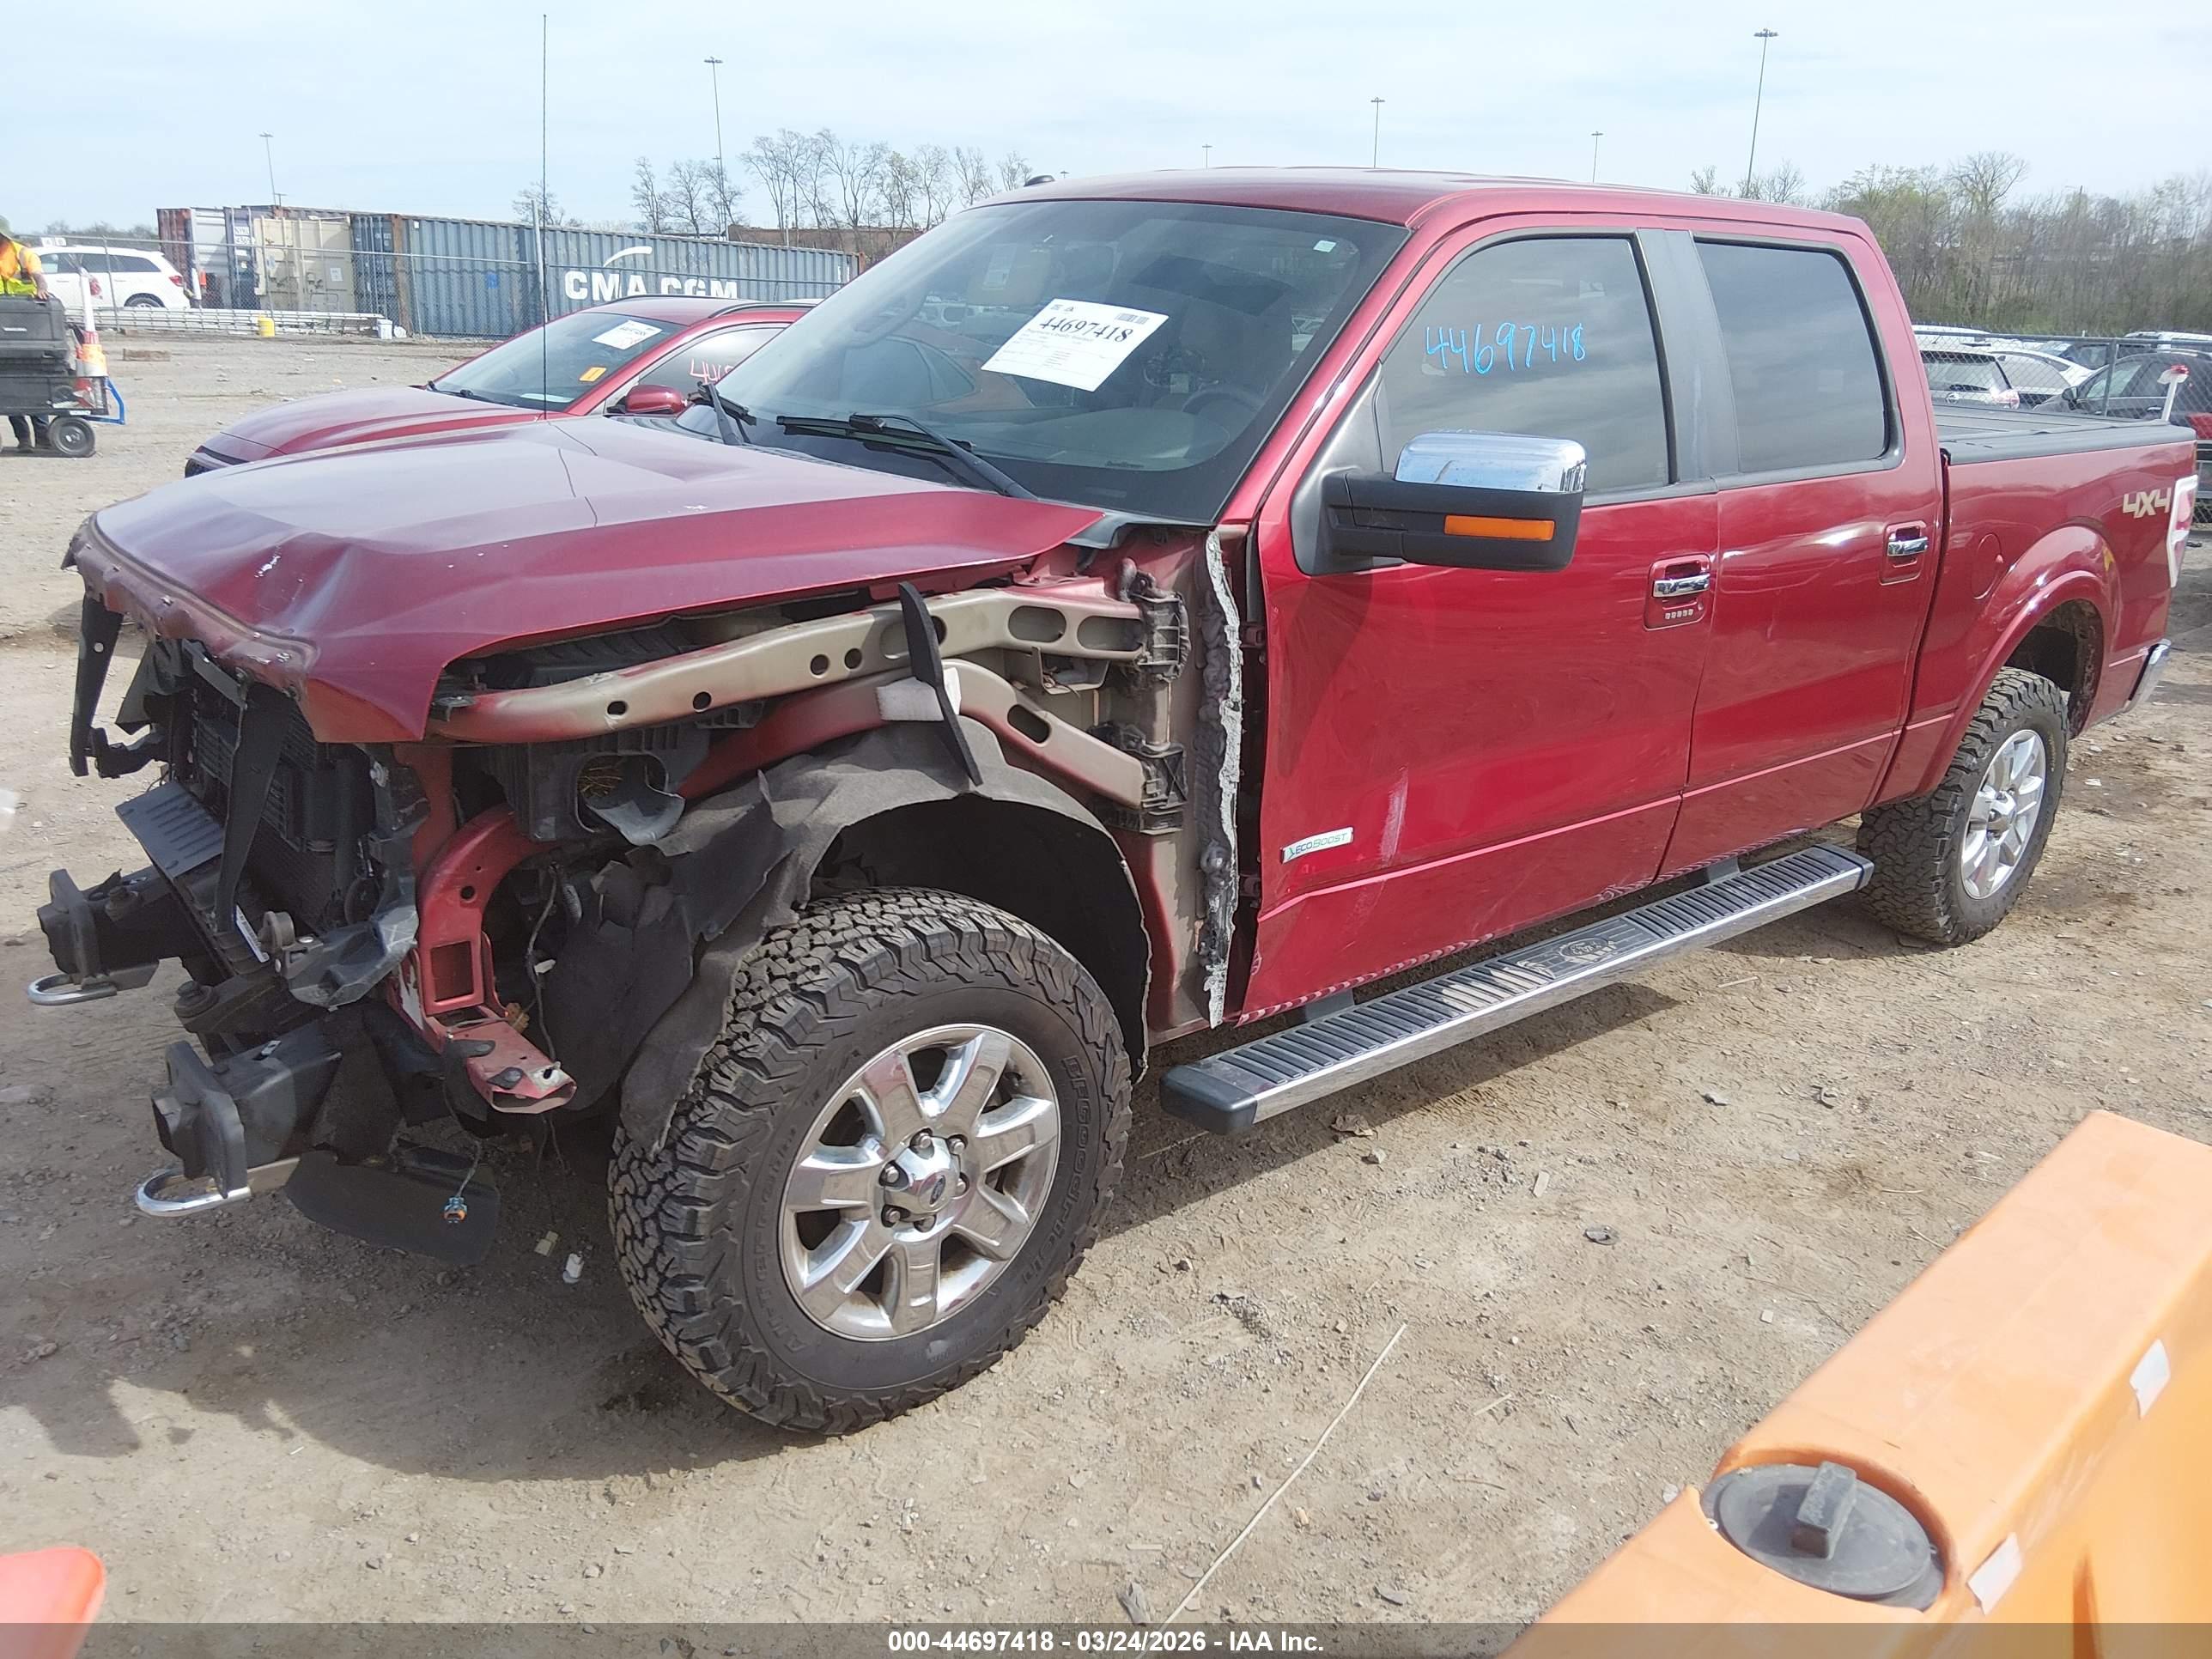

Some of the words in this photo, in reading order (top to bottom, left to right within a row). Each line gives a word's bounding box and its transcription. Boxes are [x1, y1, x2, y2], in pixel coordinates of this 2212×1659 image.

[564, 270, 648, 301] CMA
[660, 277, 738, 300] CGM
[1040, 317, 1133, 343] 44697418
[1426, 322, 1586, 374] 44697418
[690, 357, 734, 385] 44
